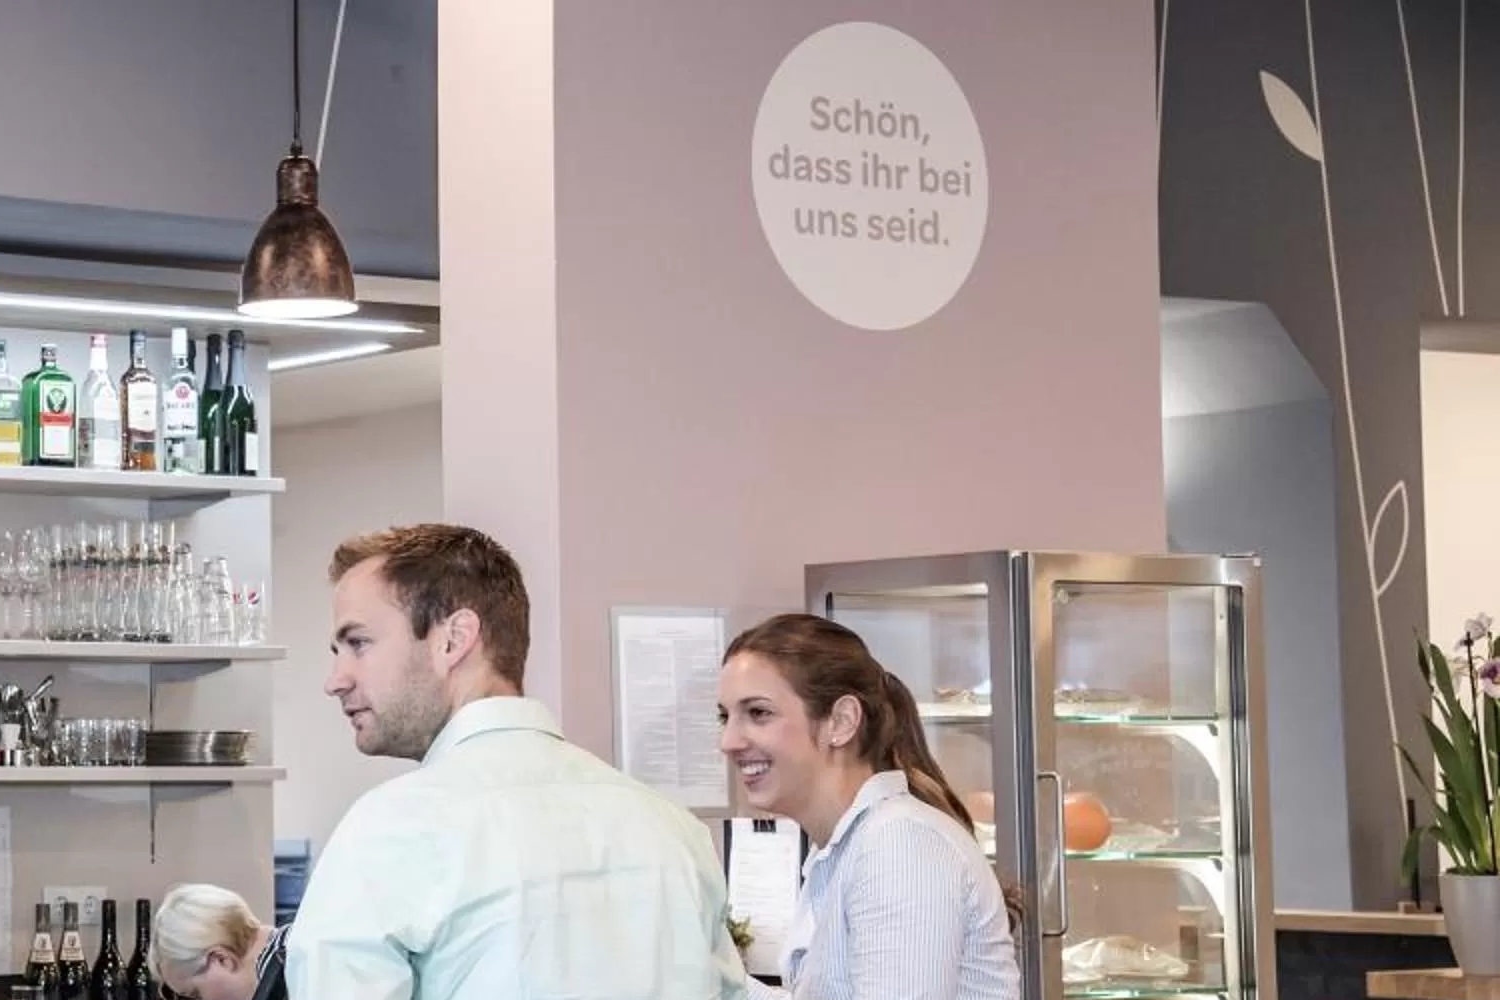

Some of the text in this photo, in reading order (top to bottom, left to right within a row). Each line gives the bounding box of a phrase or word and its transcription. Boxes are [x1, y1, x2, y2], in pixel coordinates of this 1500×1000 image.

[810, 96, 930, 146] Schön,
[769, 144, 971, 197] dass ihr bei
[794, 207, 949, 246] uns seid.
